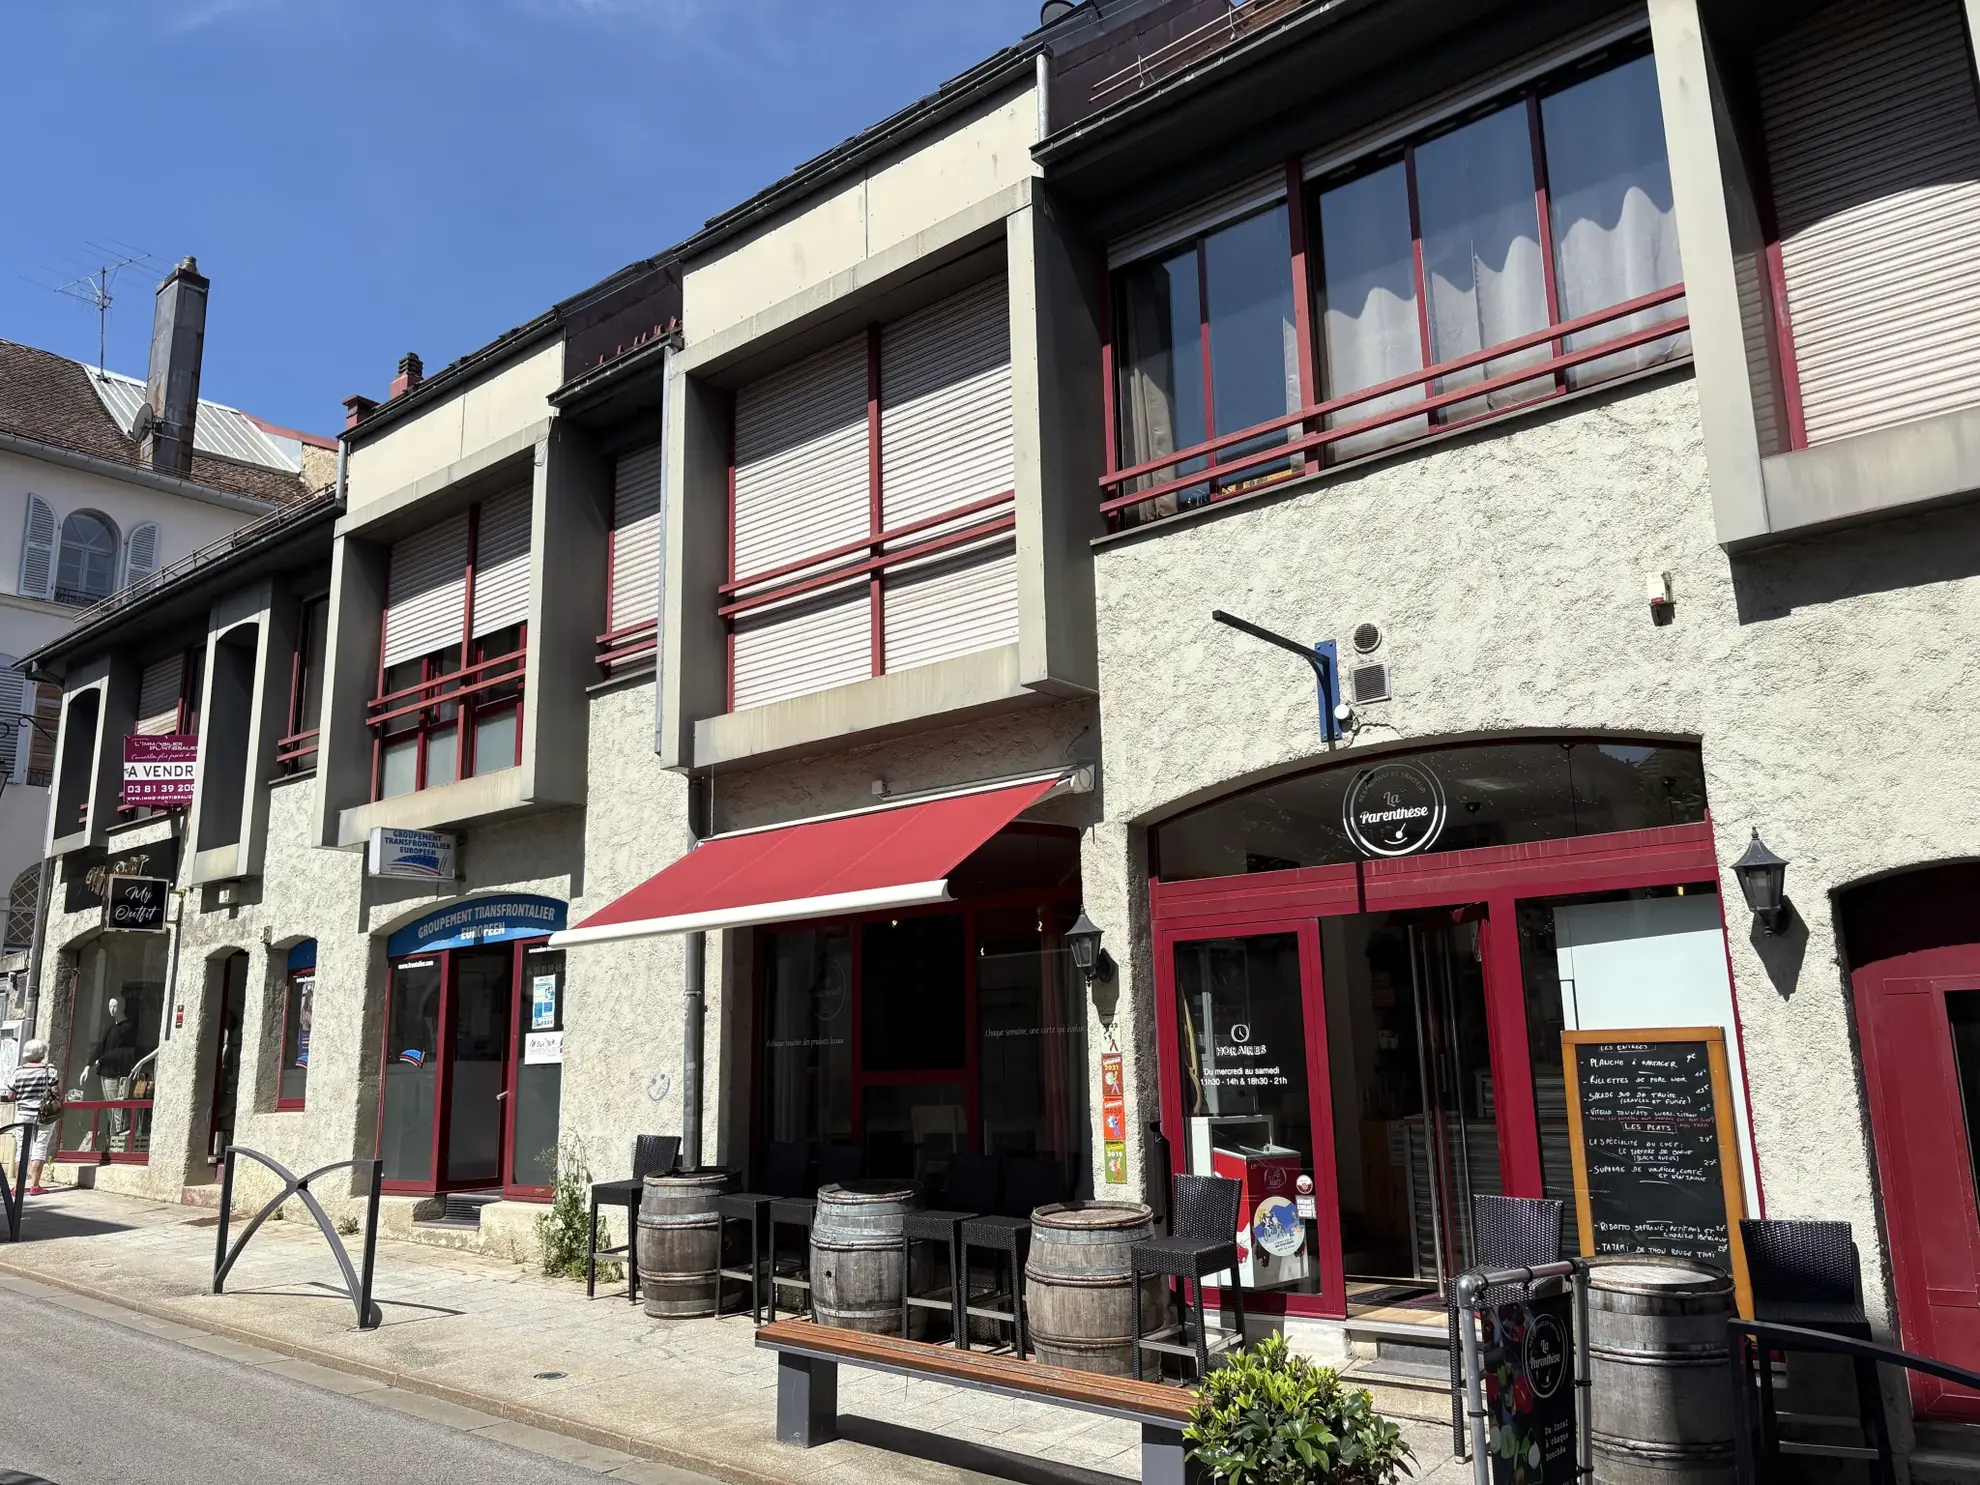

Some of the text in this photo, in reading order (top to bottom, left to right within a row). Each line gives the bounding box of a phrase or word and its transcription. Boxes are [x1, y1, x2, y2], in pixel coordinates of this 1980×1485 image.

[128, 766, 194, 778] A VENDR
[145, 785, 156, 793] 81
[161, 785, 174, 793] 39
[1383, 791, 1401, 807] La
[1360, 805, 1429, 824] Parenthèse
[393, 830, 442, 842] GROUPEMENT
[384, 837, 452, 850] TRANSFRONTALIER
[400, 847, 436, 856] EUROPEEN
[125, 886, 153, 904] My
[115, 904, 162, 923] Outfit
[418, 903, 555, 939] GROUPEMENT TRANSFRONTALIER
[461, 922, 506, 940] EUROPEEN
[1216, 1045, 1267, 1056] HORAIRES
[1204, 1068, 1214, 1076] Du
[1215, 1067, 1243, 1075] mercredi
[1255, 1066, 1280, 1075] samedi
[1200, 1078, 1221, 1086] 11h30
[1226, 1078, 1239, 1086] 14h
[1274, 1077, 1288, 1085] 21h
[1600, 1221, 1631, 1232] RISOTTO
